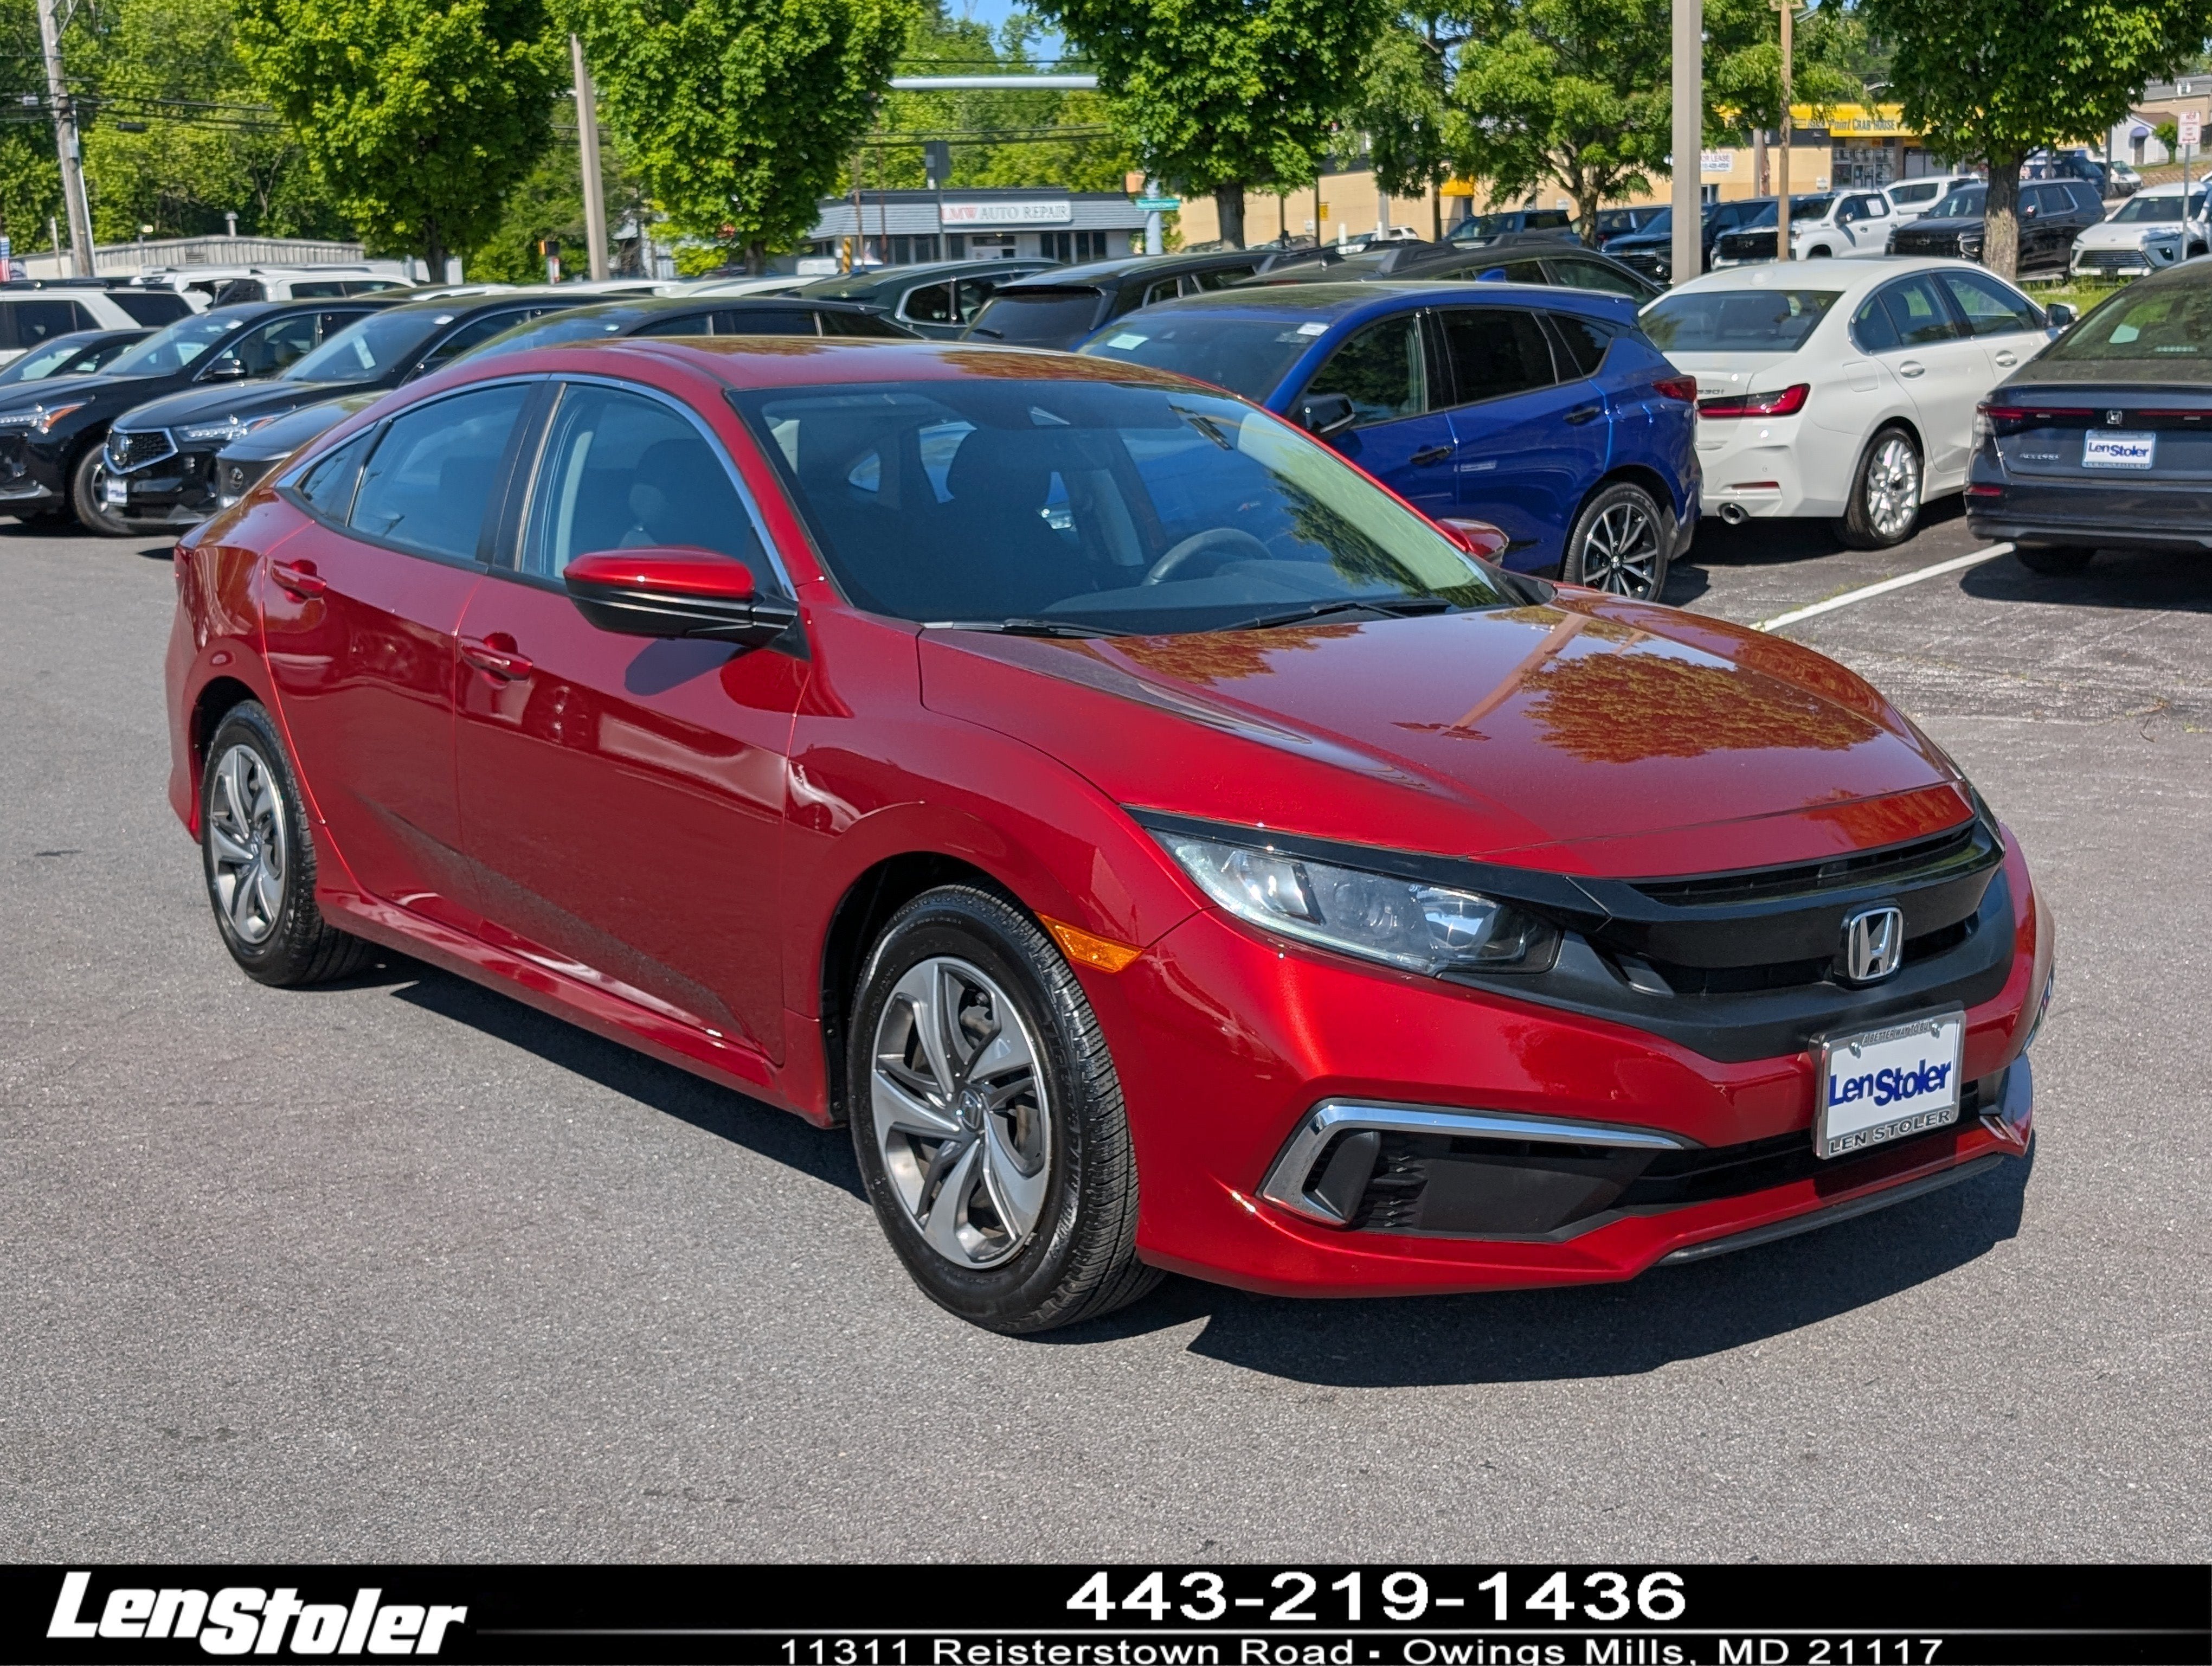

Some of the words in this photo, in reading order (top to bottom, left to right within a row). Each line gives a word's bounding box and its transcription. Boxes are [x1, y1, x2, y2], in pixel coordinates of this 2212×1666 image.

[980, 207, 1020, 220] AUTO
[1023, 206, 1067, 219] REPAIR
[2088, 442, 2149, 457] LenStoler
[1869, 1029, 1894, 1043] BETTER
[1829, 1059, 1952, 1107] LenStoler
[1829, 1131, 1867, 1155] LEN
[1874, 1110, 1951, 1140] STOLER
